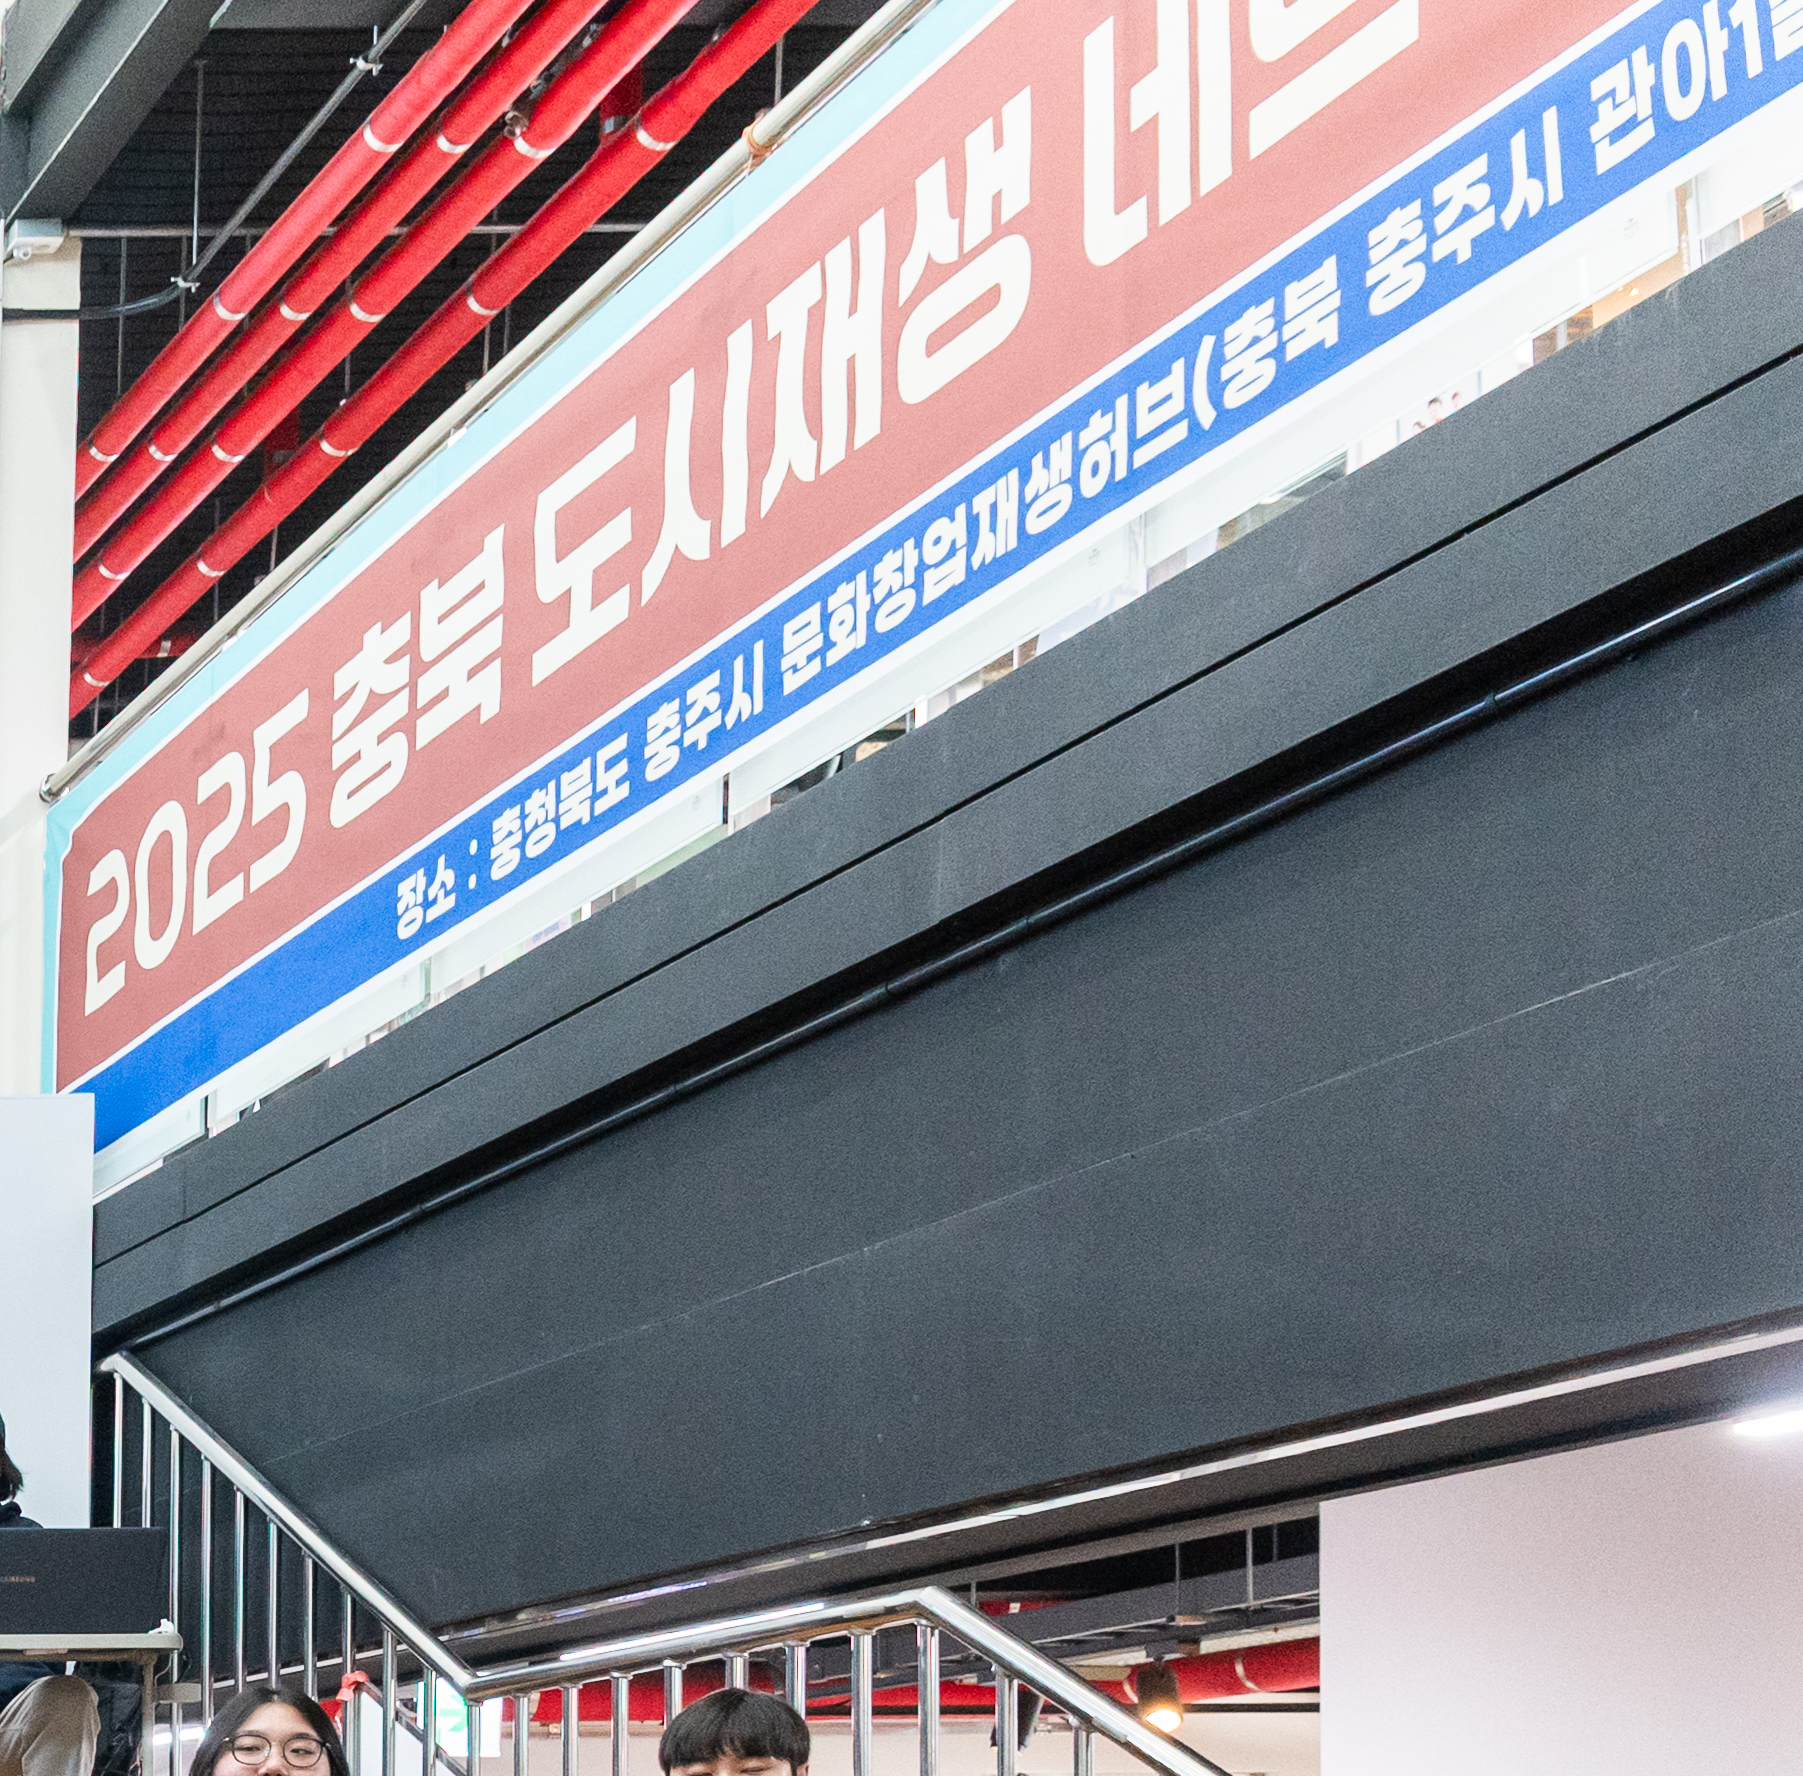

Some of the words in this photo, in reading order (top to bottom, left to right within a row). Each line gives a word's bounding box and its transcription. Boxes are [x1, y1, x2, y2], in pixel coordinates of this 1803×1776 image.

[84, 688, 310, 1017] 2025
[329, 523, 505, 829] 충북
[531, 87, 1033, 688] 도시재생
[396, 853, 456, 940] 장소
[490, 733, 630, 882] 충청북도
[644, 640, 764, 782] 충주시
[1365, 105, 1565, 318] 충주시
[1589, 0, 1803, 176] 관아1
